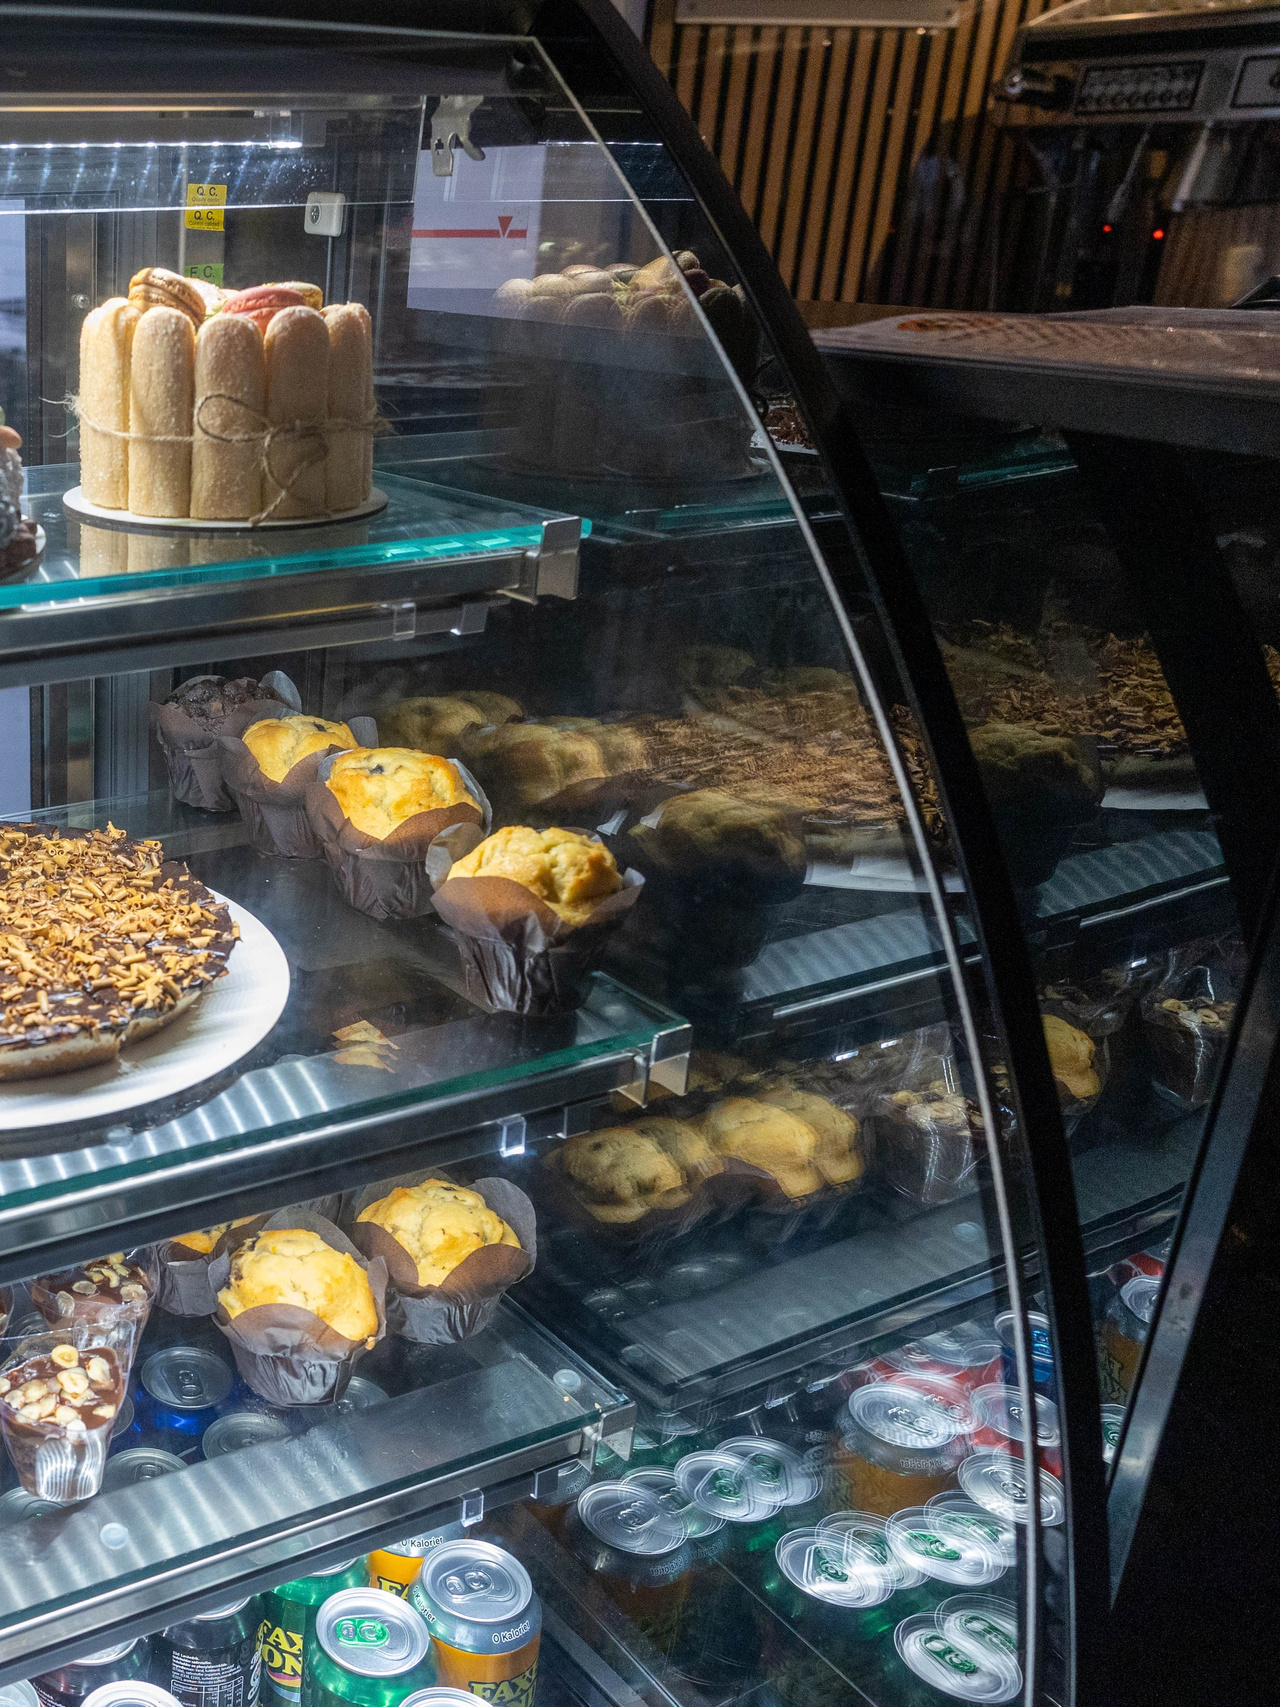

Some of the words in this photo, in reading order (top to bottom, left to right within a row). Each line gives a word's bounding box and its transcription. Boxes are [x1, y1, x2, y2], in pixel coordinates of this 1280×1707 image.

[410, 1536, 443, 1548] Kalorier
[413, 1593, 436, 1624] Kalorier
[501, 1620, 531, 1643] Kalorier
